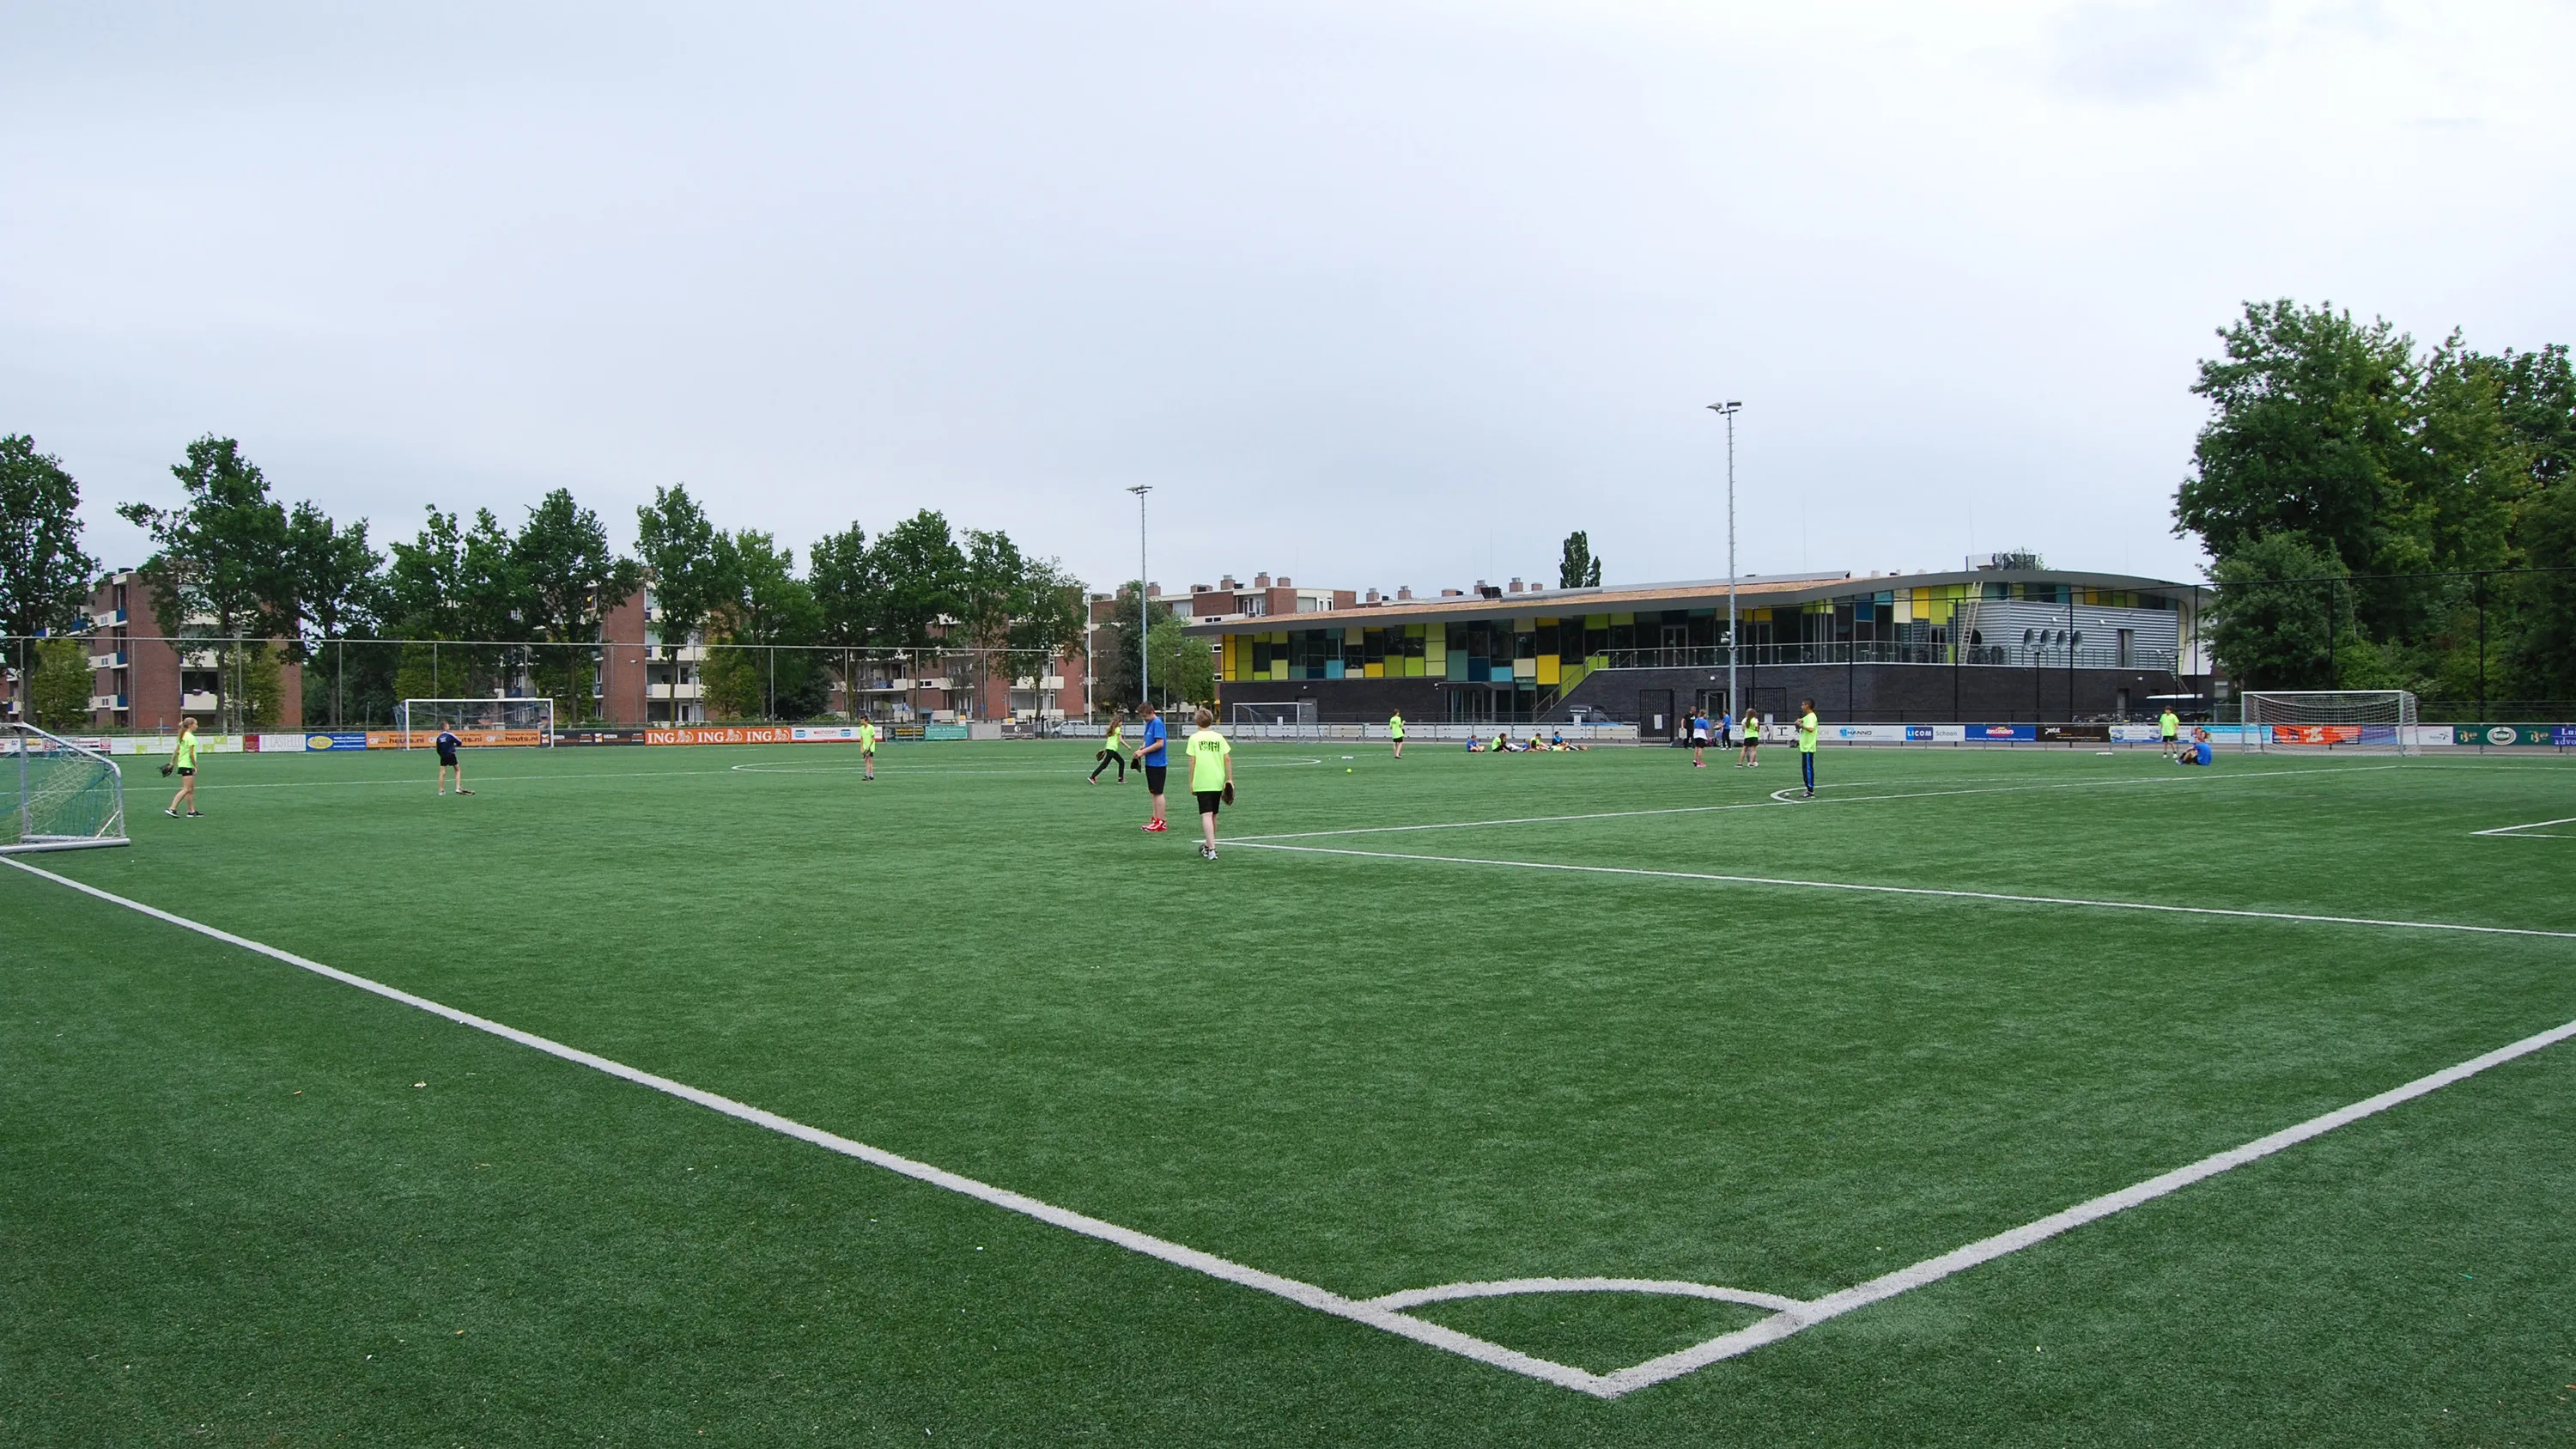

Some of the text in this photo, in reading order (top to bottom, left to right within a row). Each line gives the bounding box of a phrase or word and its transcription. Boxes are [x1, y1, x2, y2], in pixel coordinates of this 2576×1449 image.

[270, 735, 303, 747] CASTELLO
[647, 733, 675, 743] ING
[697, 732, 724, 742] ING
[746, 731, 772, 741] ING
